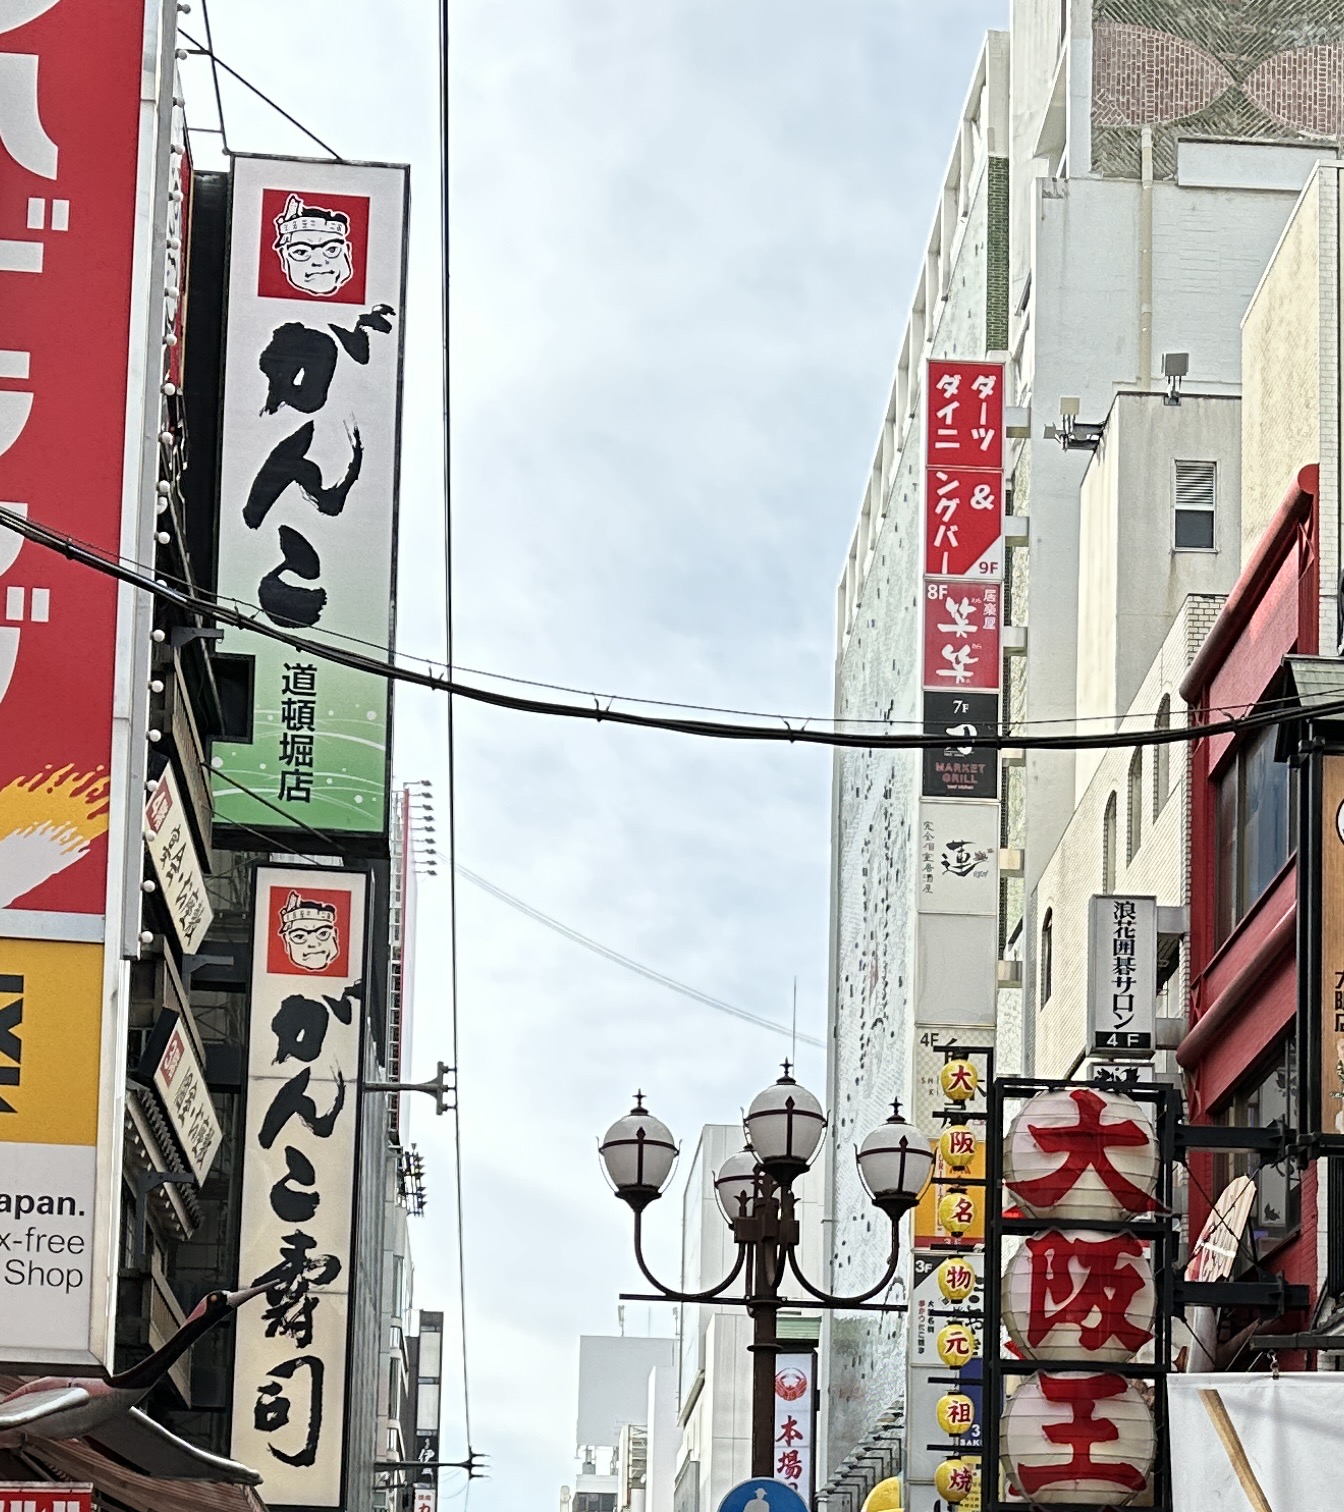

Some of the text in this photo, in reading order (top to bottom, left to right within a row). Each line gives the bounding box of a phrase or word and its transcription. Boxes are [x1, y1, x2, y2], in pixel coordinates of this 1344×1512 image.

[969, 373, 997, 452] ダーツ
[243, 303, 396, 629] がんこ
[933, 373, 963, 575] ダイニングバー
[978, 560, 999, 575] 9F
[927, 583, 948, 600] 8F
[952, 700, 970, 714] 7F
[277, 663, 318, 804] 道頓堀店
[935, 762, 986, 773] MARKET
[942, 773, 978, 785] GRILL
[1110, 900, 1138, 1030] 浪花囲碁サロン
[920, 1032, 940, 1048] 4F
[4, 1258, 84, 1294] Shop
[914, 1260, 934, 1274] 3F
[775, 1414, 805, 1494] 本場
